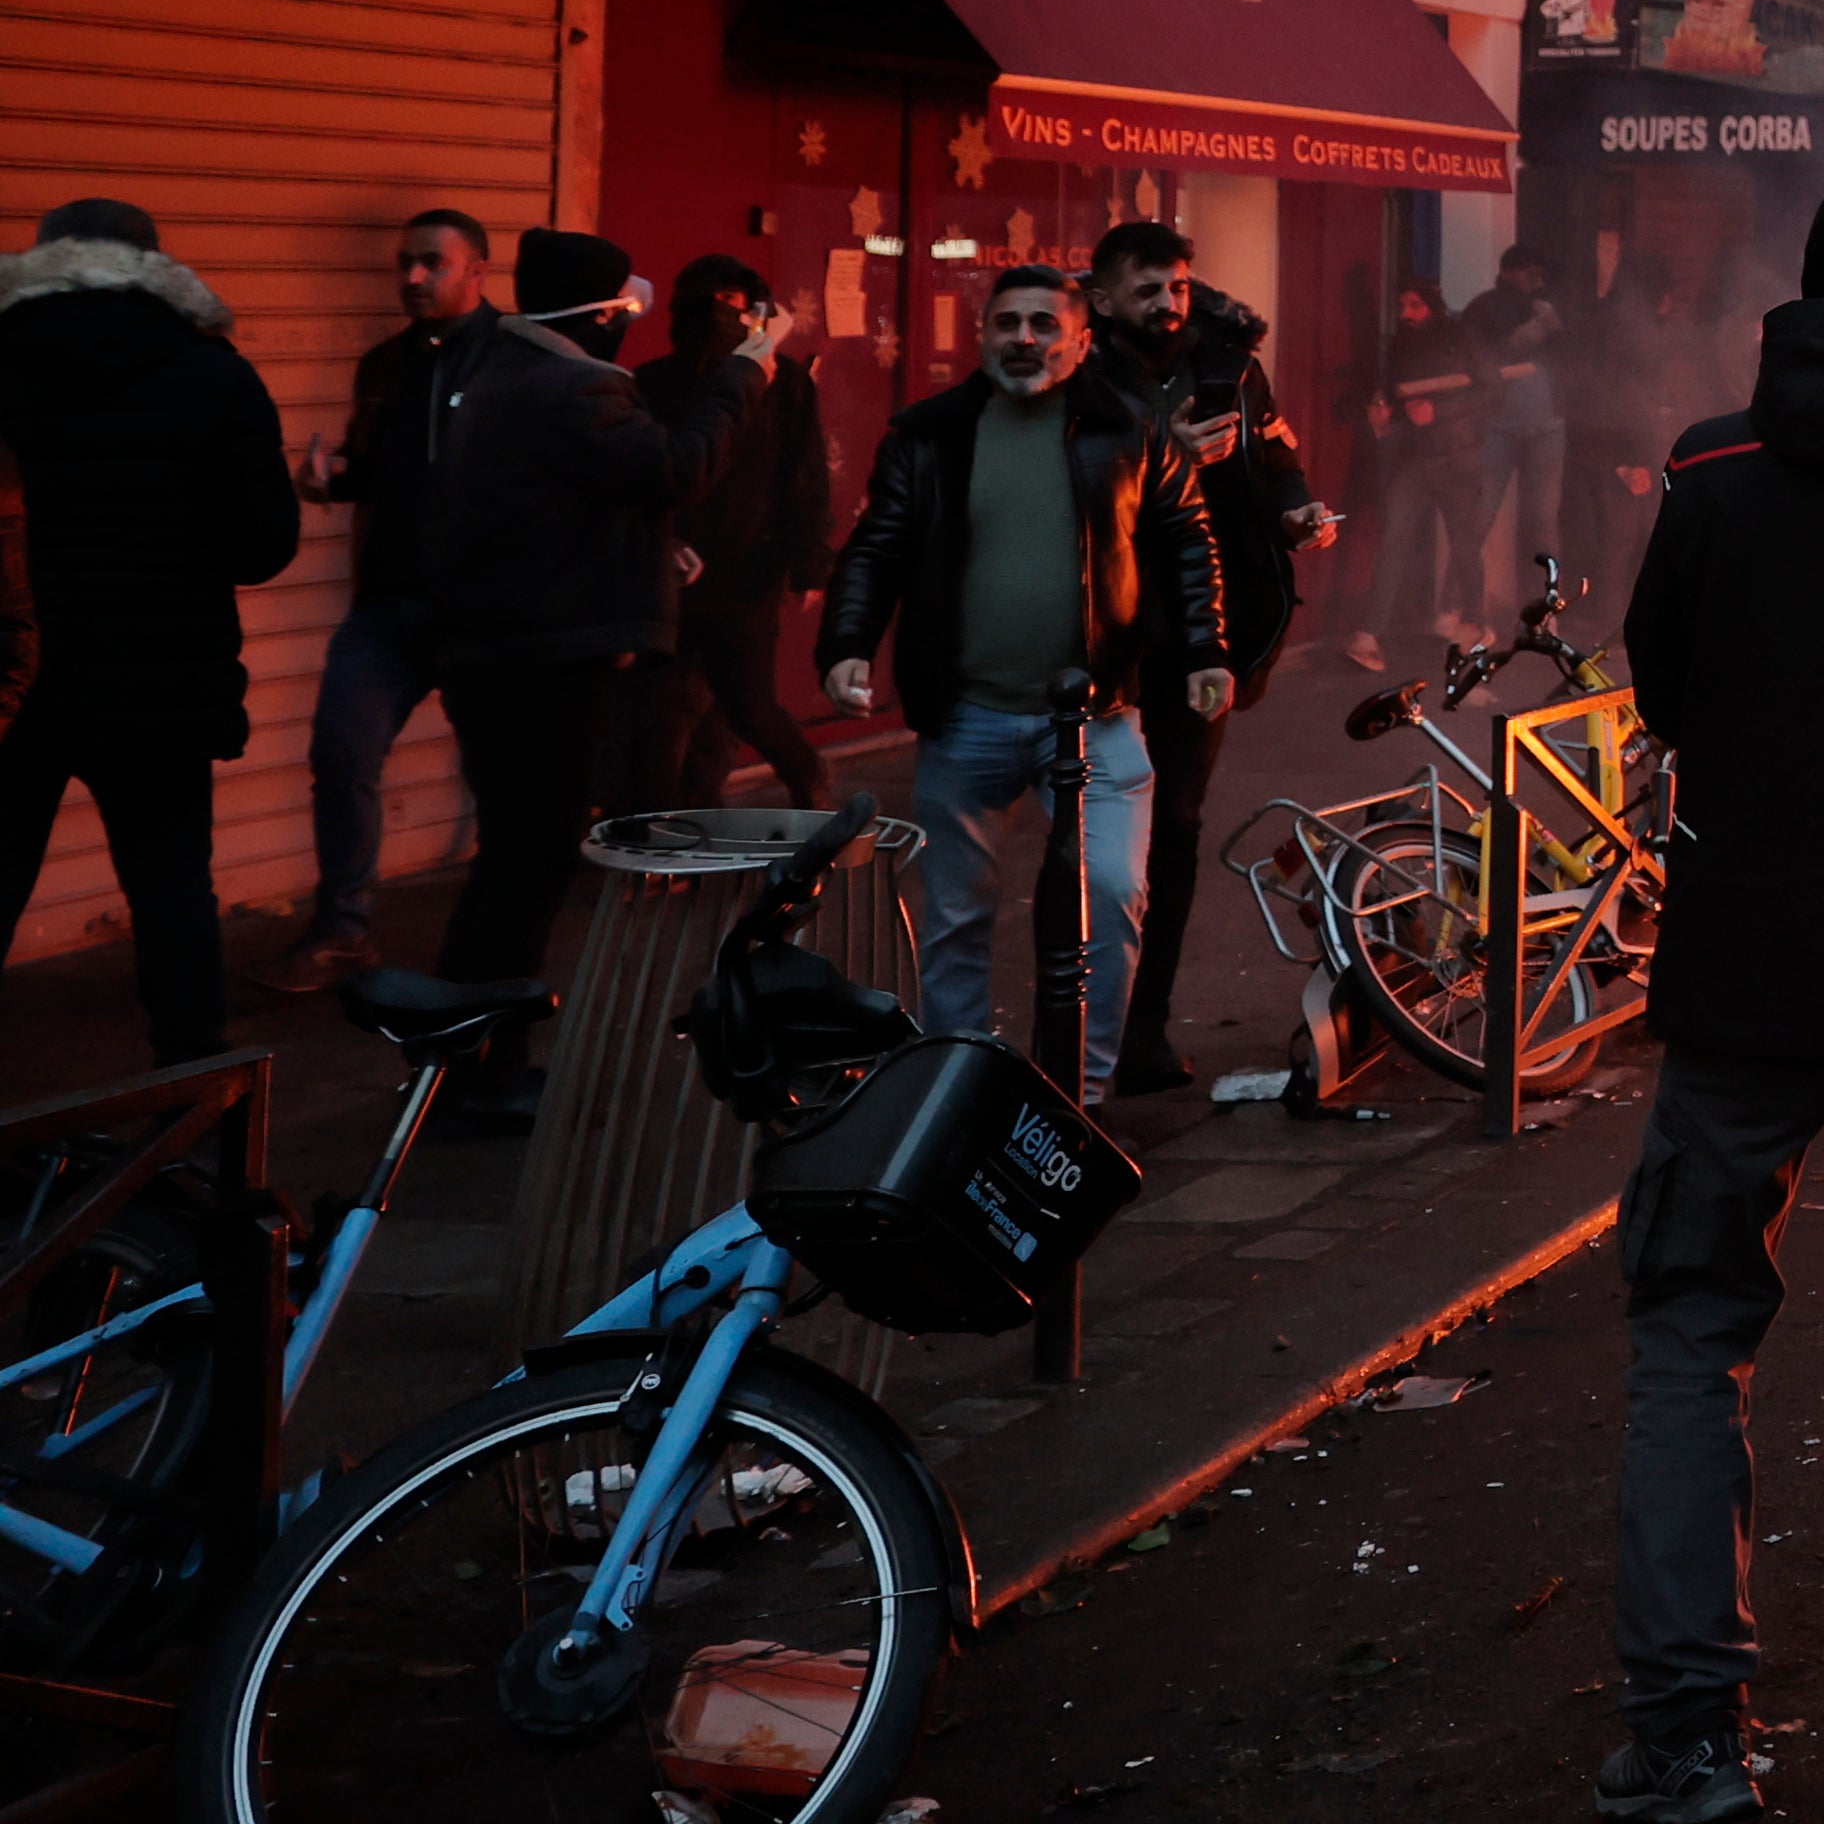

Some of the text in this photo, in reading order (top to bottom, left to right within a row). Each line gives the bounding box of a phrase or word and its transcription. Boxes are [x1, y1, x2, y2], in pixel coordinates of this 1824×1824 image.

[1001, 105, 1072, 147] VINS
[1101, 118, 1277, 162] CHAMPAGNES
[1293, 133, 1406, 172] COFFRETS
[1412, 145, 1504, 180] CADEAUX
[1601, 115, 1709, 152] SOUPES
[1012, 1103, 1081, 1192] Véligo
